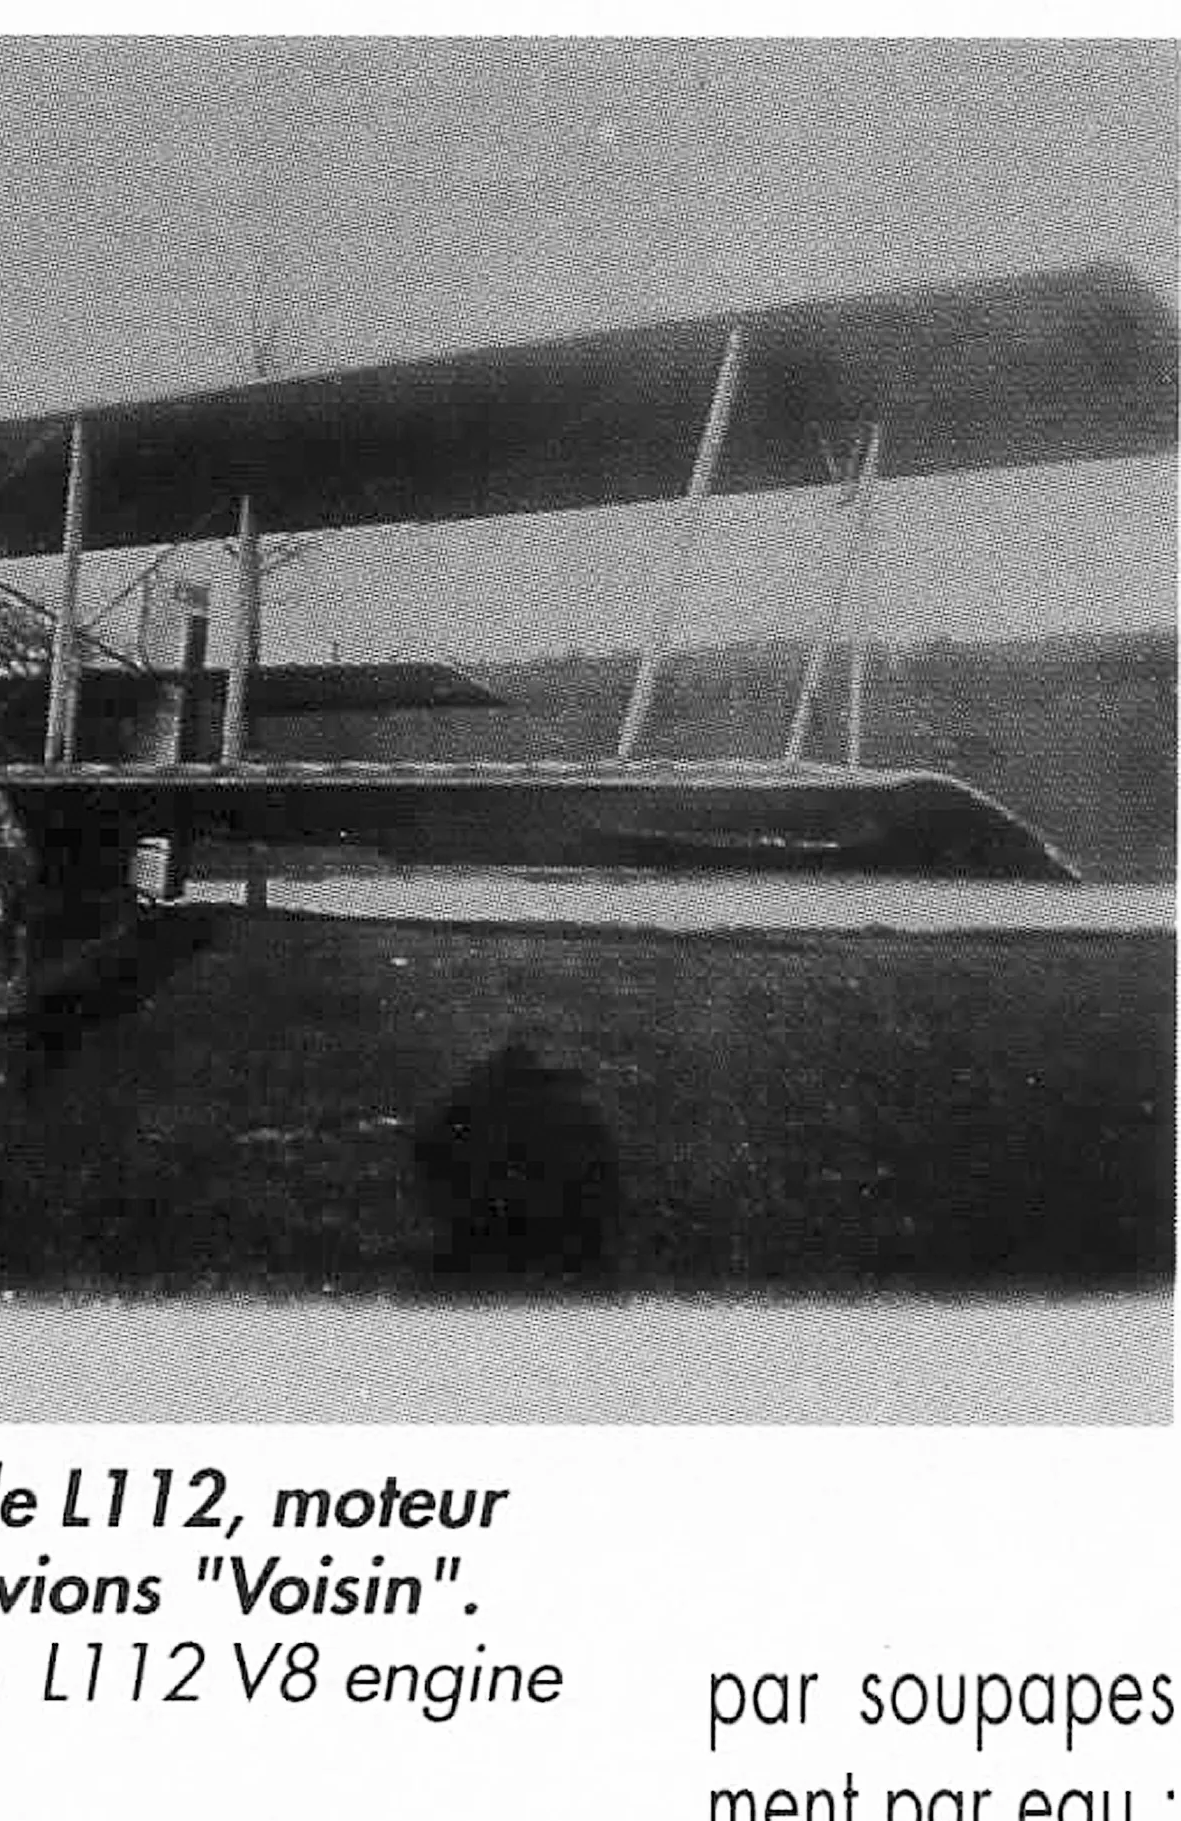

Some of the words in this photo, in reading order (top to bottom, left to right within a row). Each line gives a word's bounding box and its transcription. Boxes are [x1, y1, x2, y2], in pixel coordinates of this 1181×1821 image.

[63, 1468, 243, 1539] L112,
[273, 1477, 510, 1529] moteur
[198, 1555, 477, 1615] "Voisin".
[44, 1641, 205, 1701] L112
[234, 1642, 319, 1702] V8
[346, 1644, 562, 1722] engine
[711, 1673, 818, 1751] par
[861, 1674, 1174, 1751] soupapes
[711, 1773, 858, 1821] ment
[1019, 1789, 1131, 1821] eau
